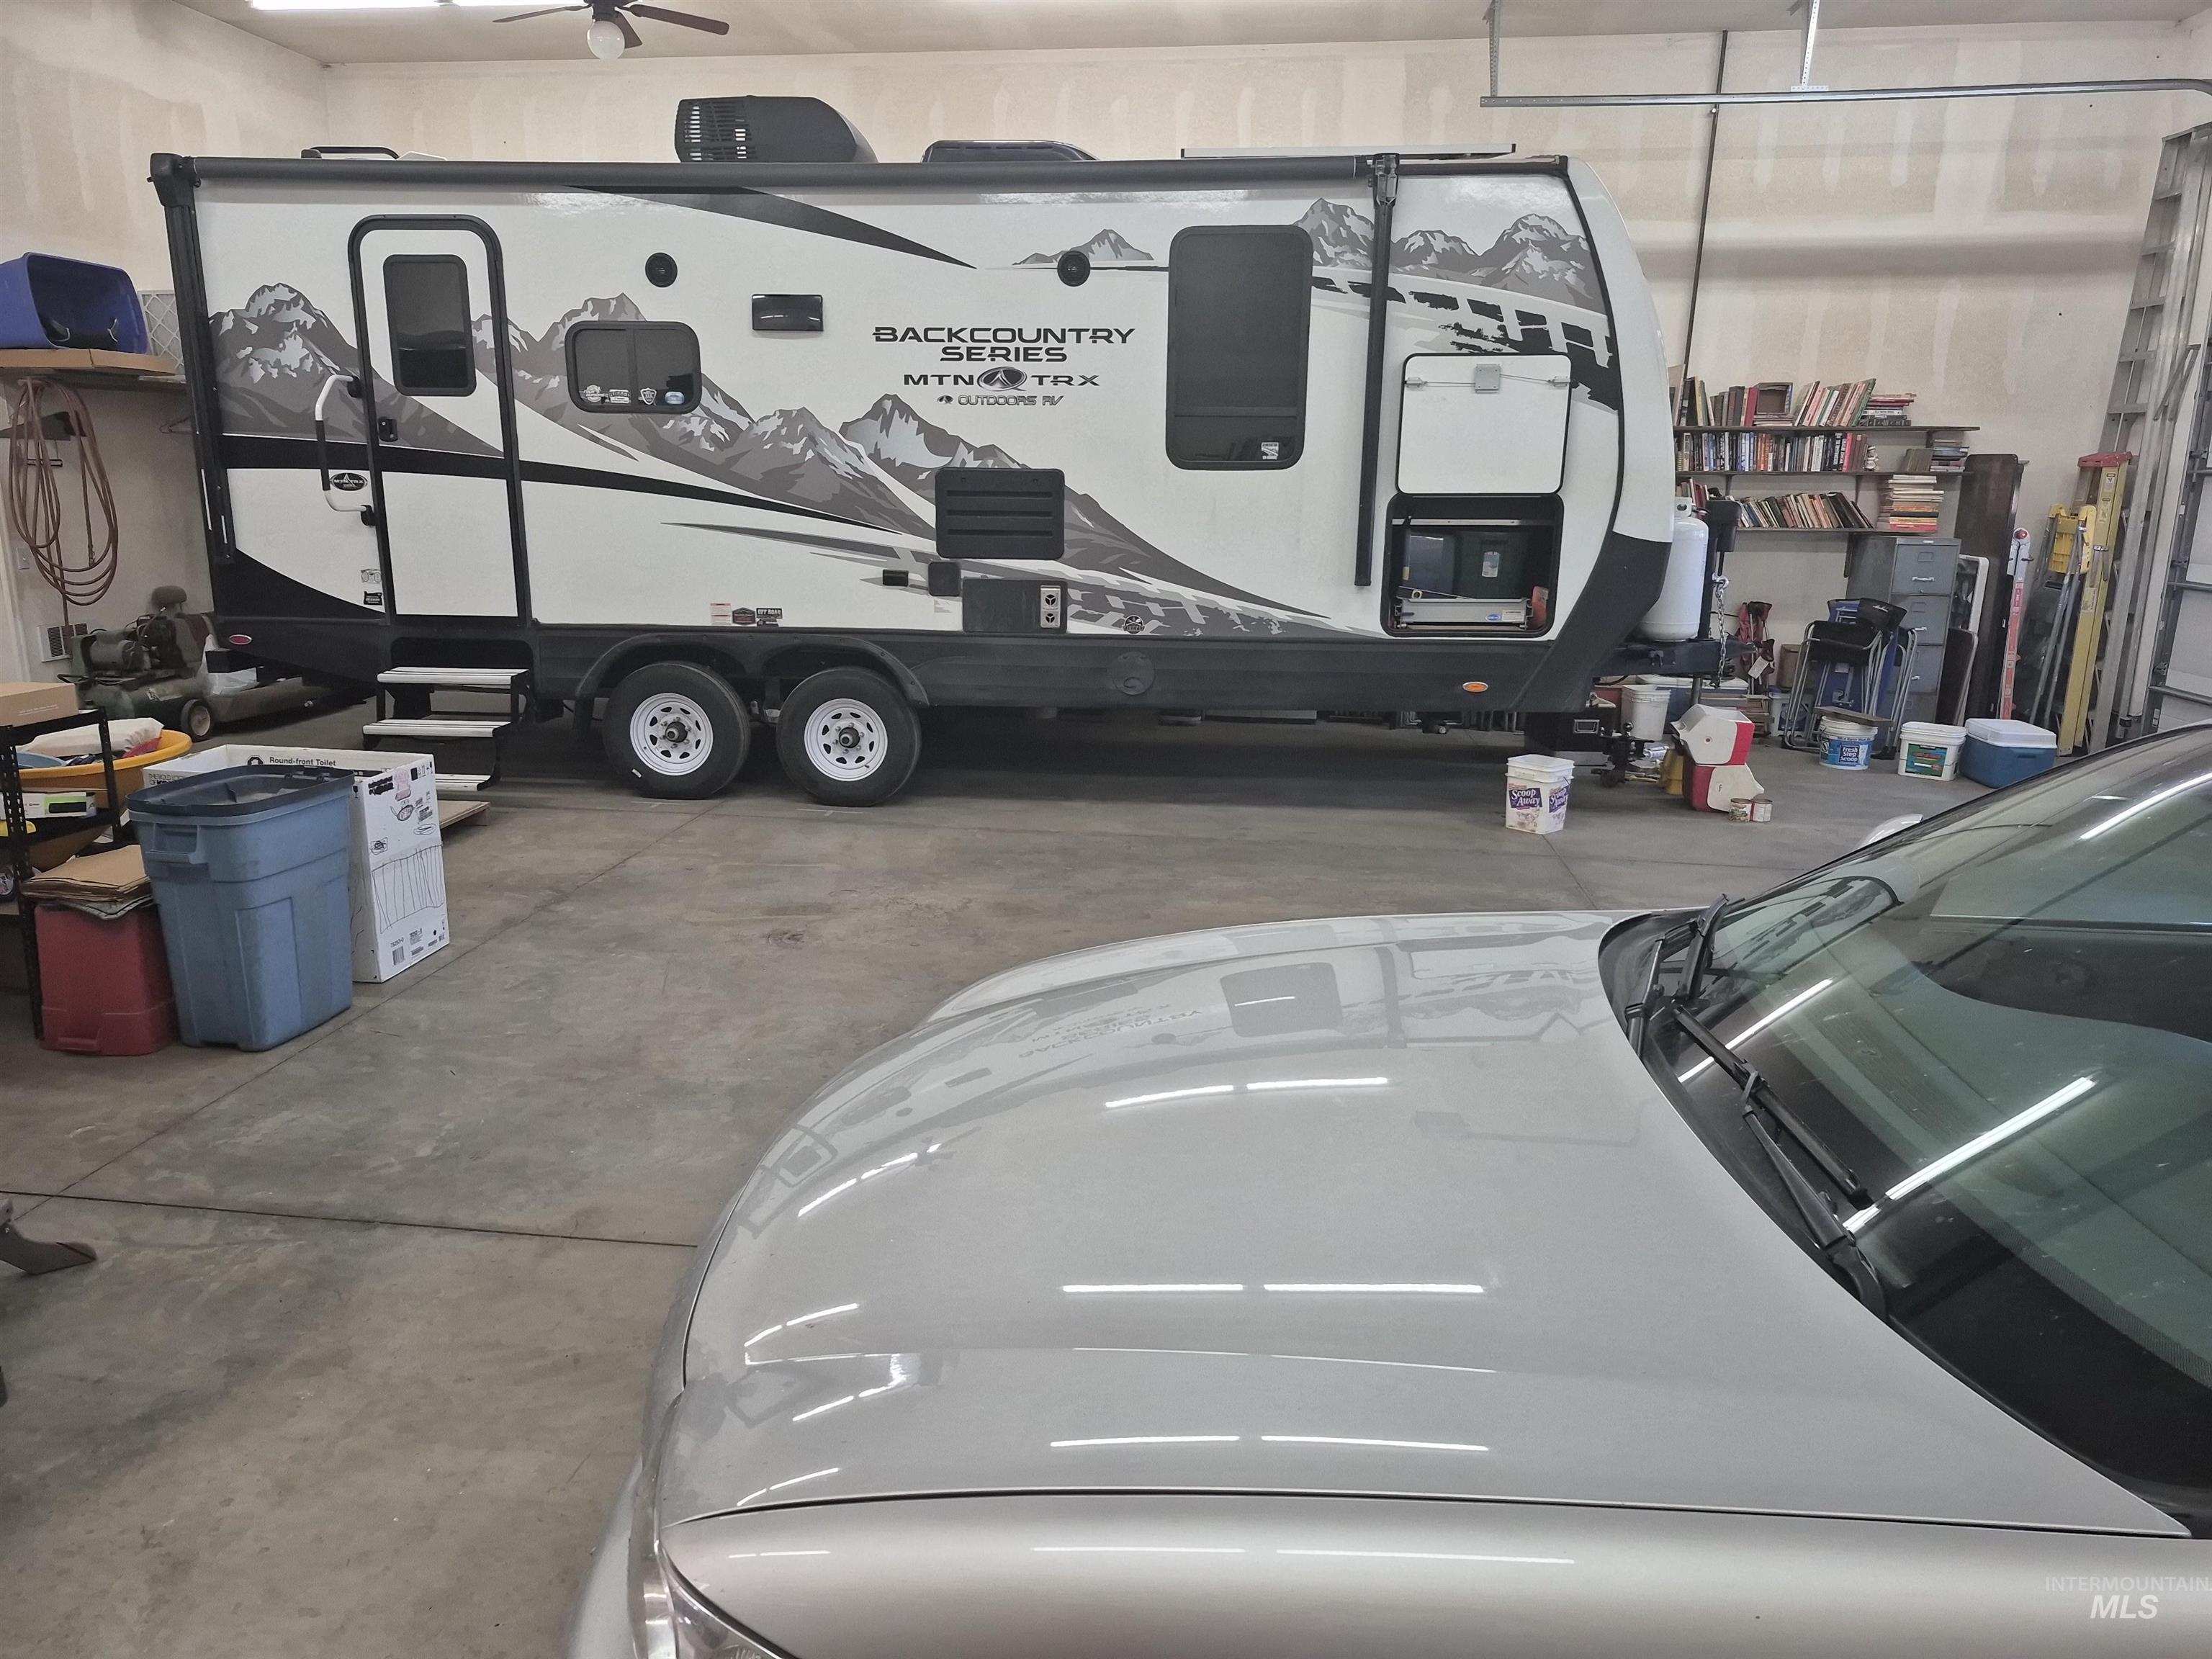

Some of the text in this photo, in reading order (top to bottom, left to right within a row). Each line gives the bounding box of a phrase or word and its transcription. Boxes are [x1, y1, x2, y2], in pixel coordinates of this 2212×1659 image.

[873, 327, 1136, 344] BACKCOUNTRY
[940, 346, 1067, 362] SERIES
[904, 374, 1100, 386] MTN TRX
[958, 395, 1064, 406] OUTDOORS RV
[269, 757, 313, 765] Round-front
[1511, 789, 1536, 800] Scoop
[1516, 796, 1540, 806] Away
